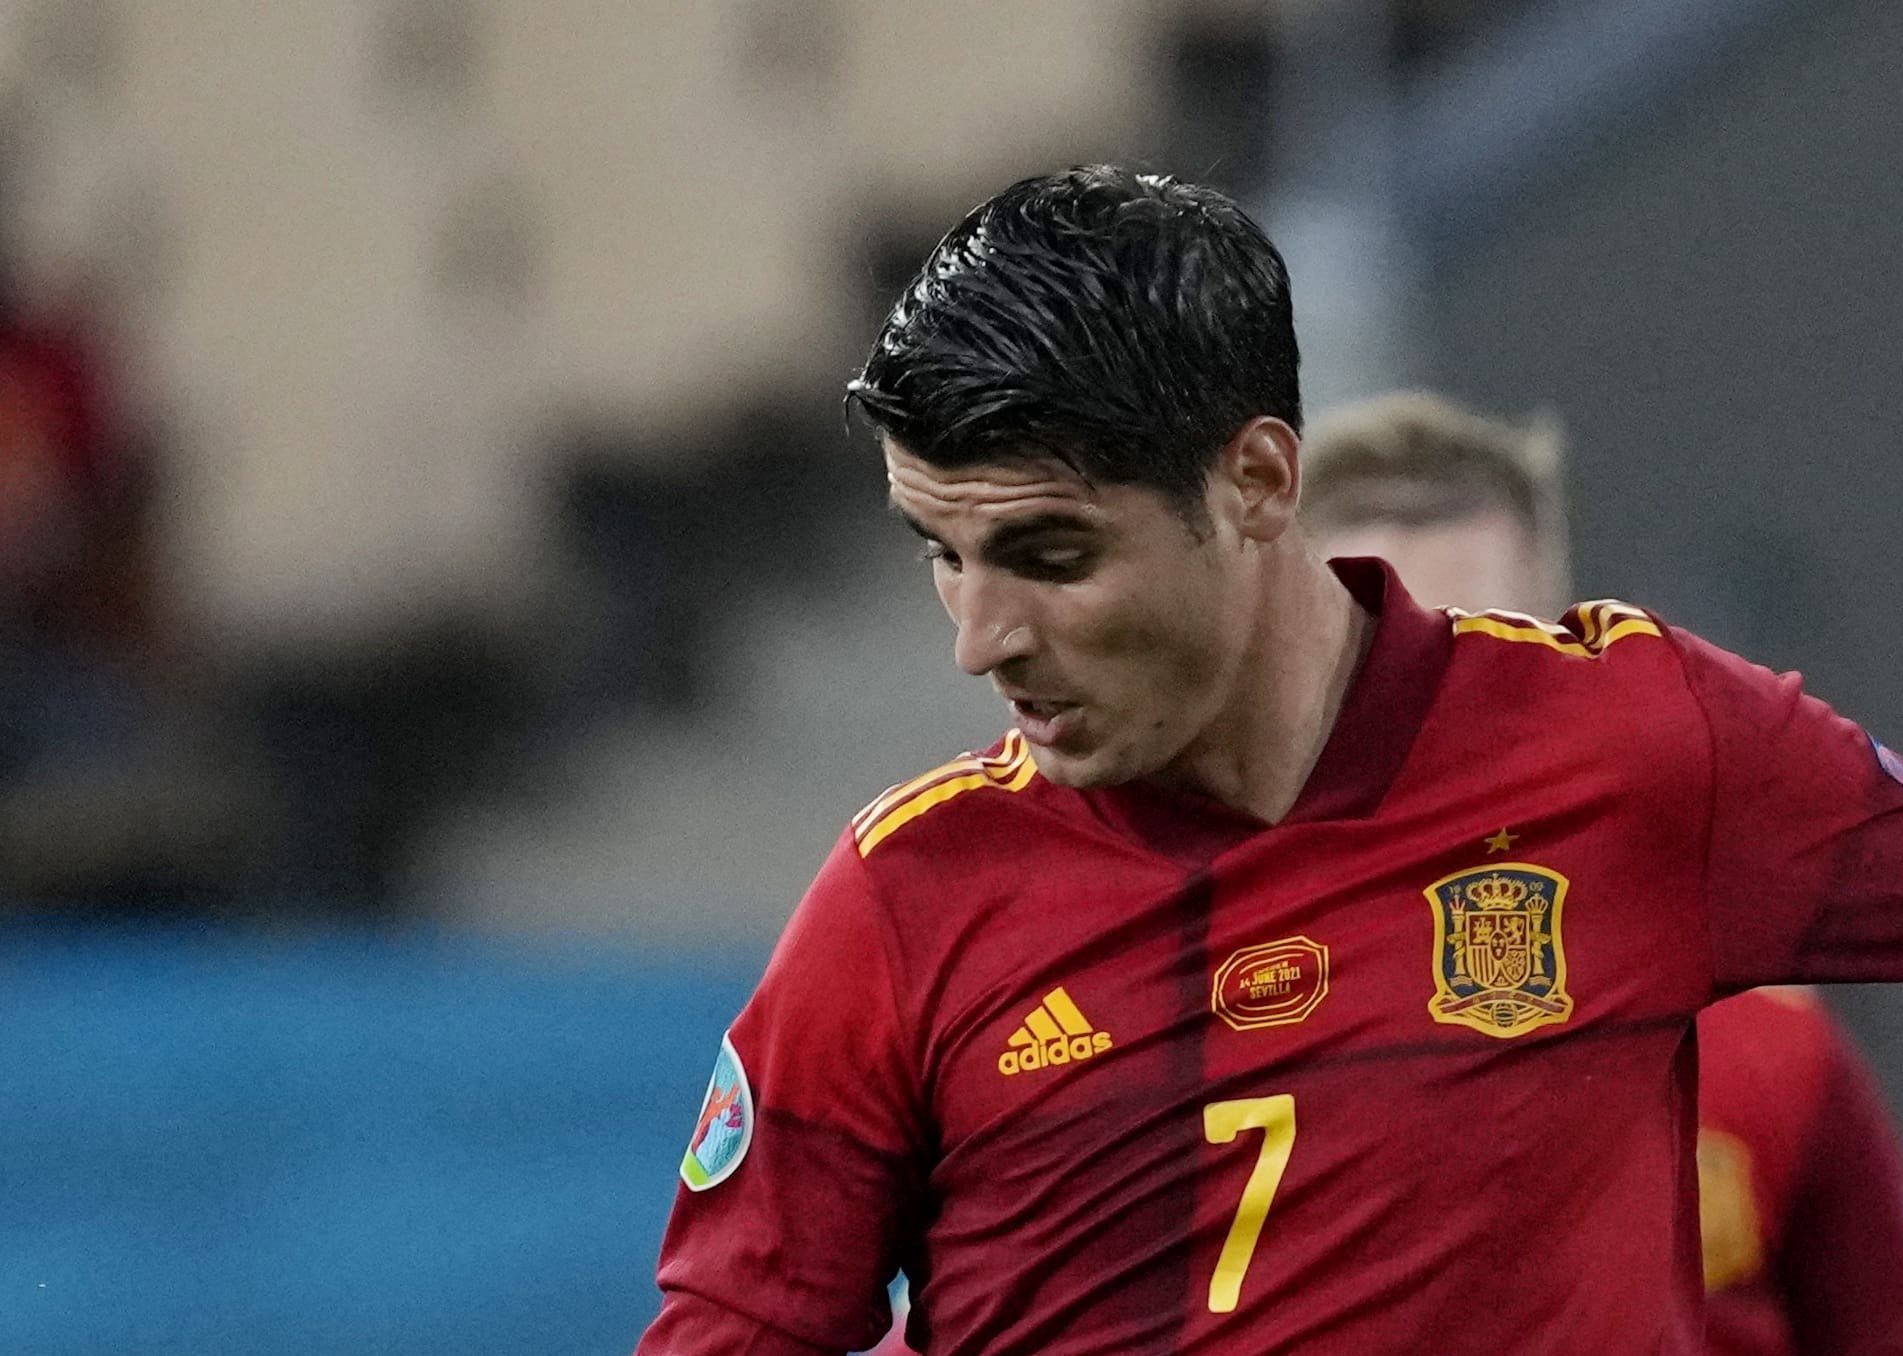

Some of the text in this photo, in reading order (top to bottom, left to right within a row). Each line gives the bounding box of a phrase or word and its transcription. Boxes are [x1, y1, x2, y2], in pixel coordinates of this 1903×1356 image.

[1278, 966, 1301, 981] 2021
[1249, 982, 1291, 999] SEVILLA
[998, 1031, 1113, 1076] adidas
[1203, 1094, 1296, 1313] 7
